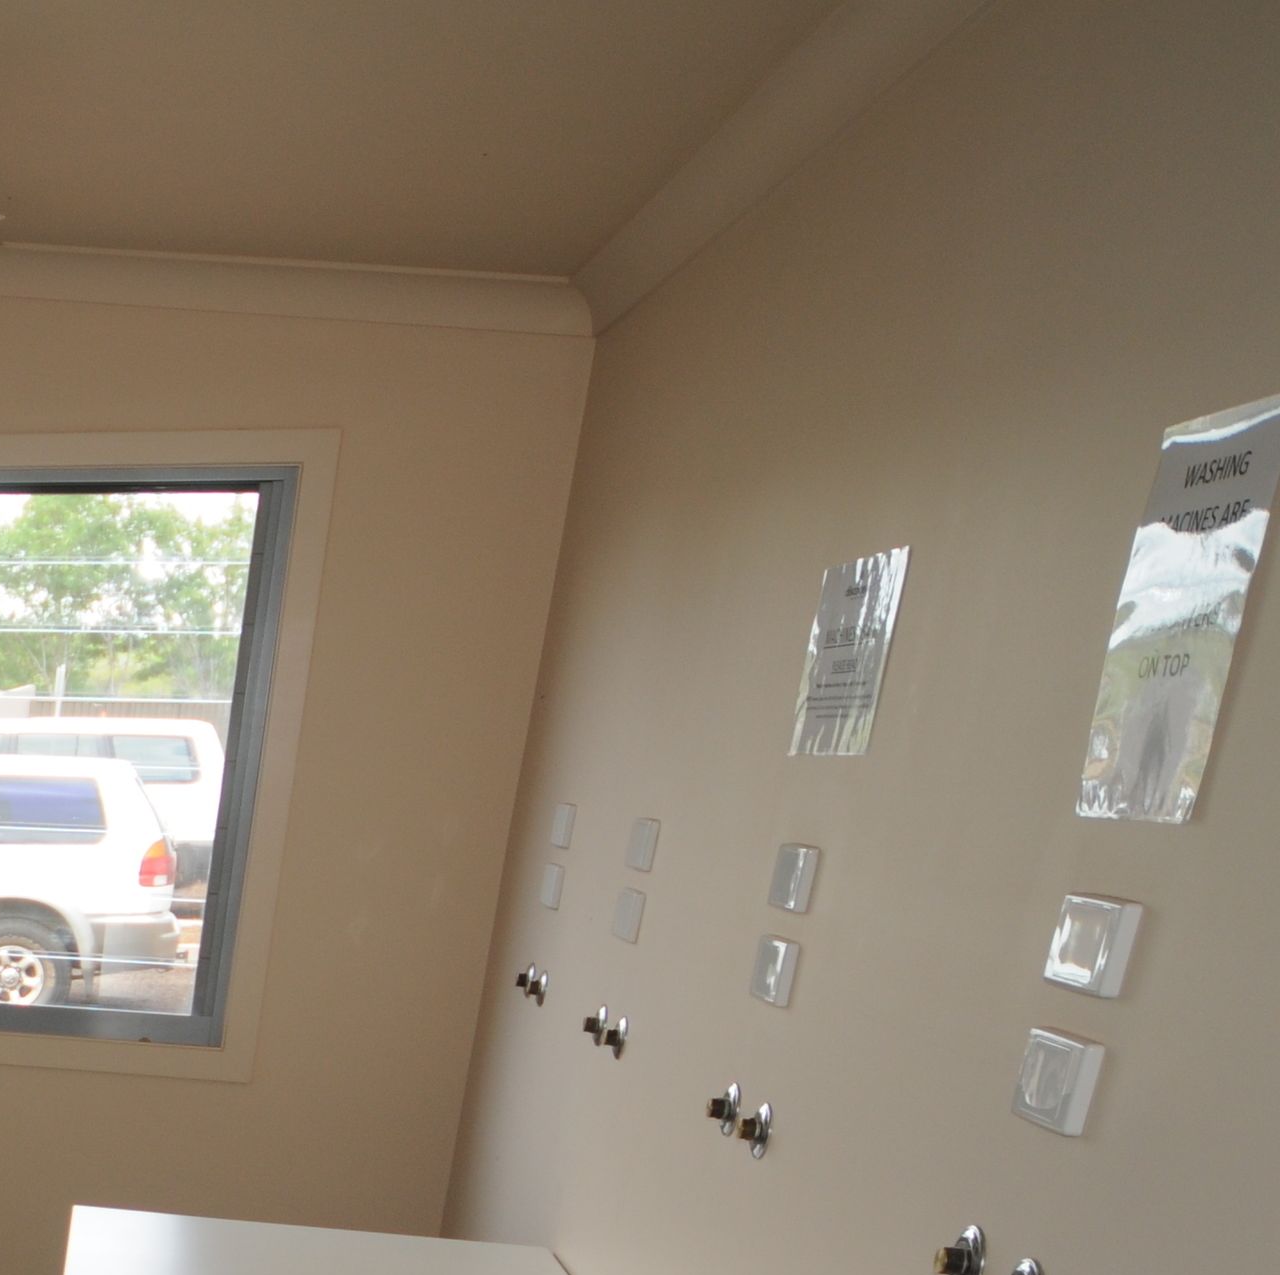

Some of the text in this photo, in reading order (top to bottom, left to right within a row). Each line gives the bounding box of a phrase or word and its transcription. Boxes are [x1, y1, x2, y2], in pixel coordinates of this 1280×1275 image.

[1184, 450, 1252, 488] WASHING
[1138, 653, 1190, 679] ON TOP
